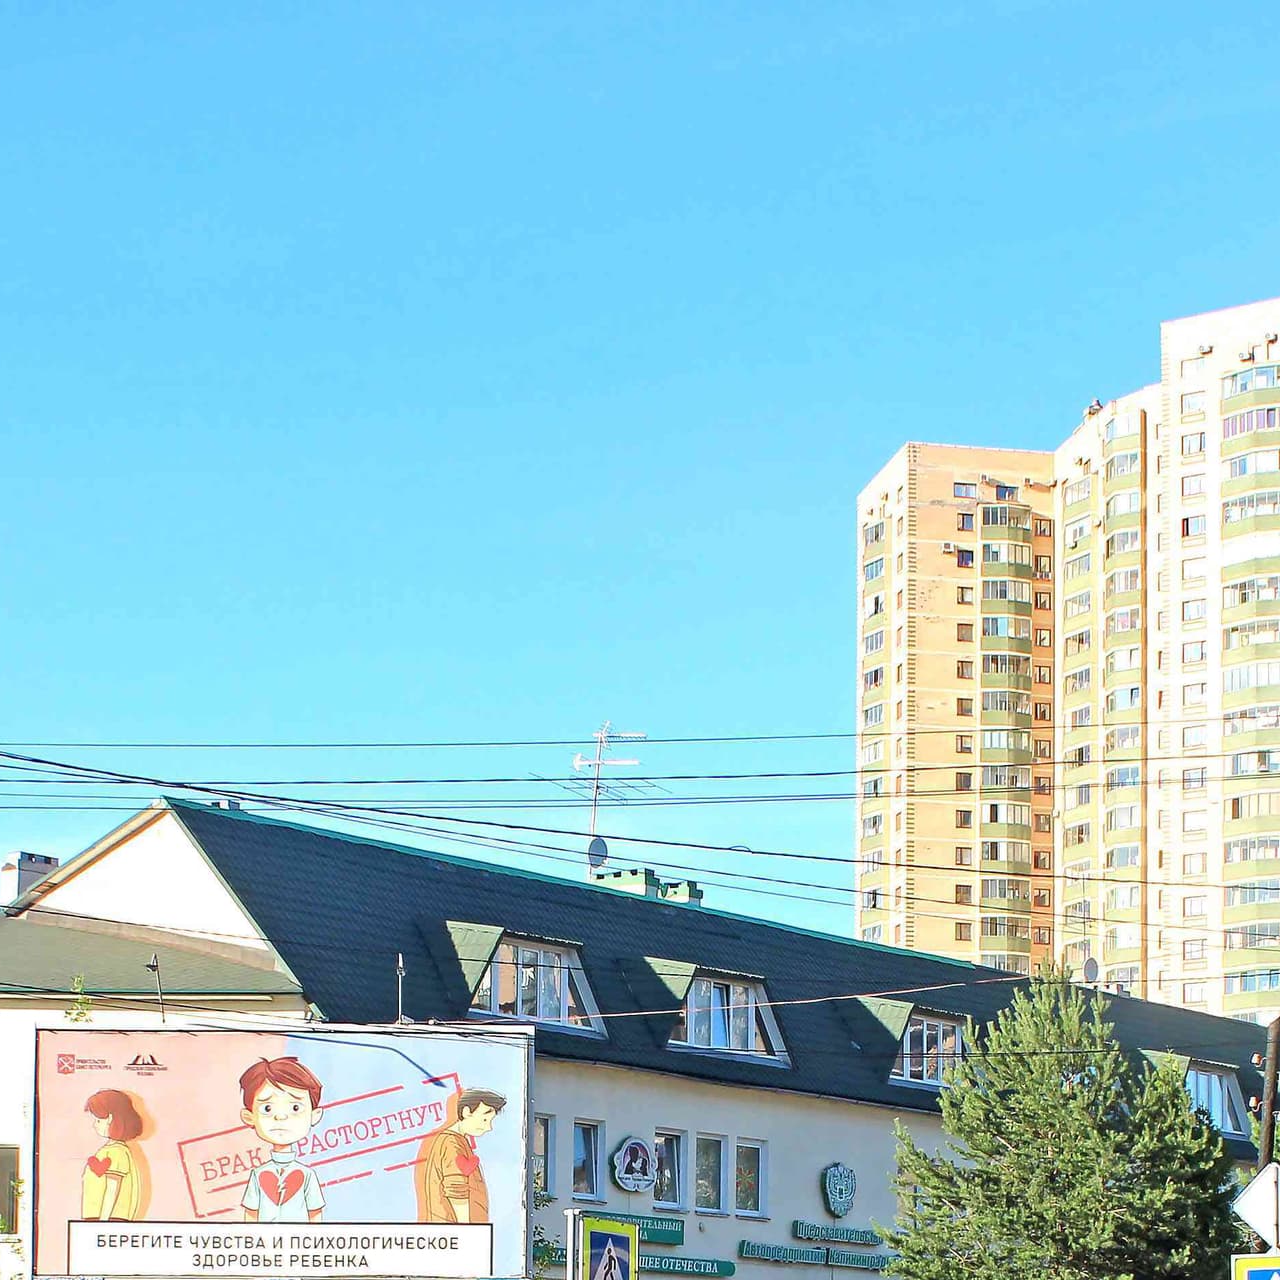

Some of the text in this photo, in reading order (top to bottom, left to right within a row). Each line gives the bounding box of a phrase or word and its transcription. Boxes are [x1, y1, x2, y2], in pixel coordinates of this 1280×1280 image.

[200, 1101, 444, 1182] БРАК РАСТОРГНУТ
[97, 1234, 459, 1250] БЕРЕГИТЕ ЧУВСТВА И ПСИХОЛОГИЧЕСКОЕ
[192, 1254, 369, 1269] ЗДОРОВЬЕ РЕБЕНКА
[661, 1257, 718, 1274] ОТЕЧЕСТВА
